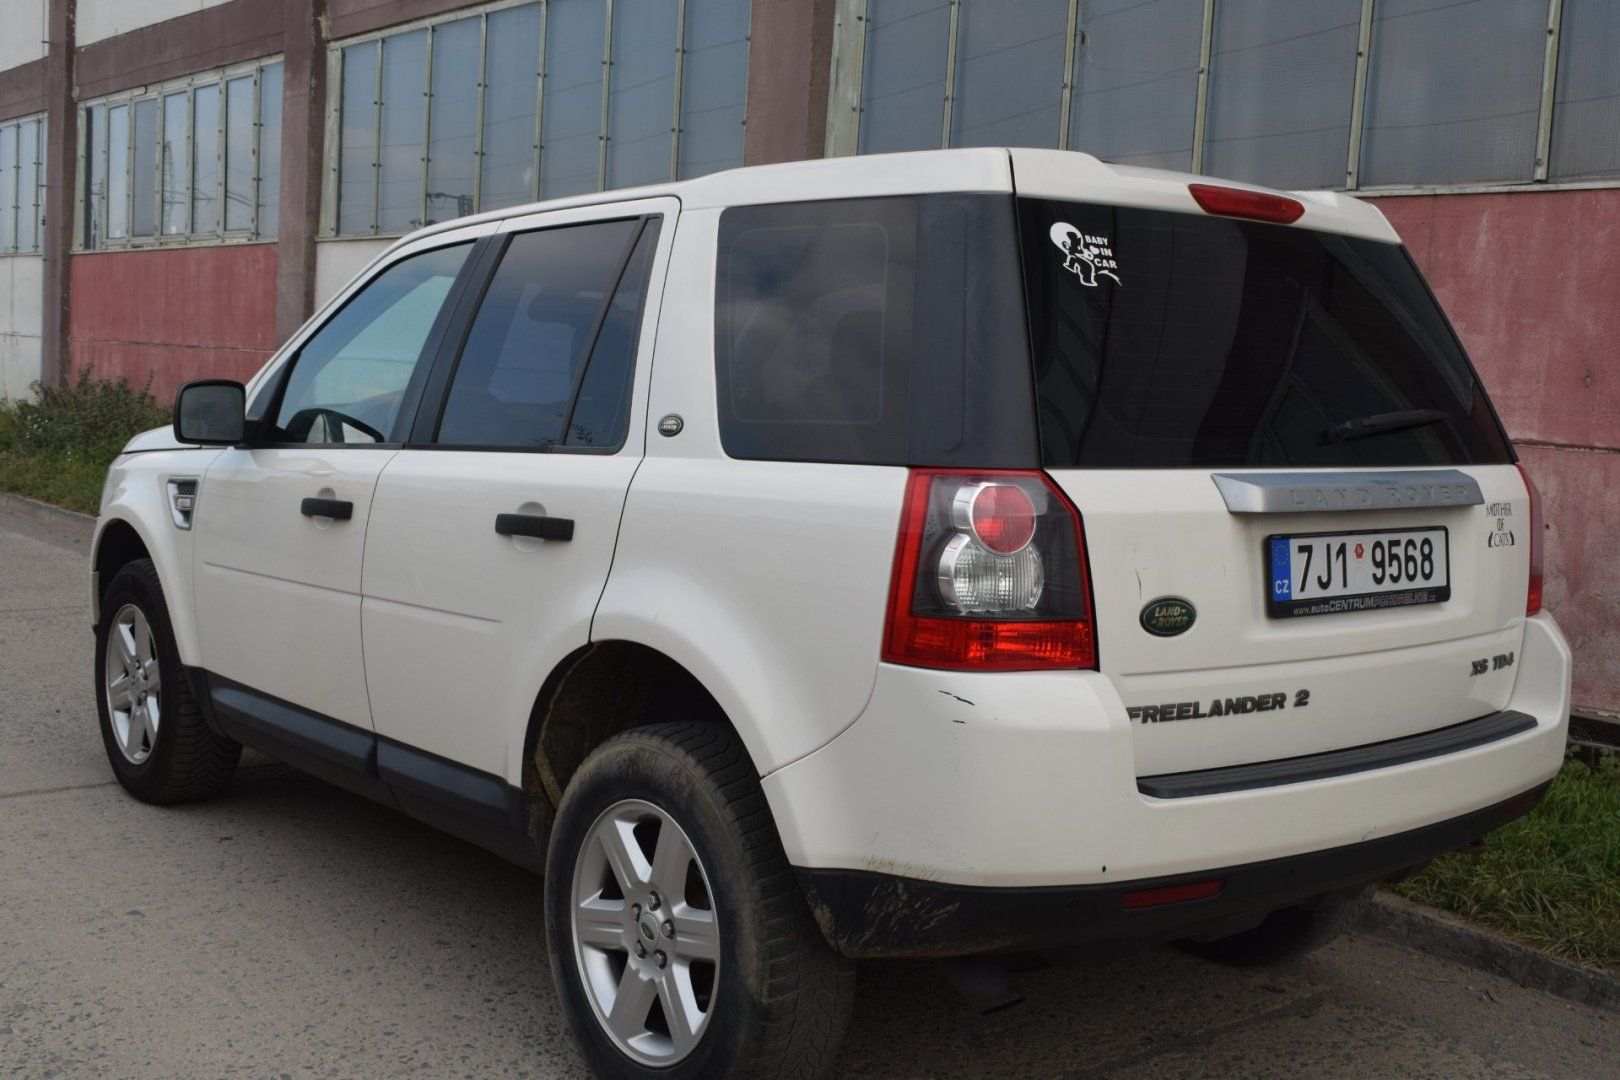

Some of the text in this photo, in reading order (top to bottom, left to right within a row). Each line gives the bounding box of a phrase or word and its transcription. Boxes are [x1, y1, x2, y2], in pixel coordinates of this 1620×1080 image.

[1084, 234, 1108, 246] BABY
[1100, 247, 1113, 257] IN
[1094, 258, 1118, 269] CAR
[1290, 485, 1468, 508] LAND ROVER
[1297, 537, 1434, 592] 7J1 9568
[1275, 579, 1289, 594] CZ
[1126, 689, 1310, 724] FREELANDER 2
